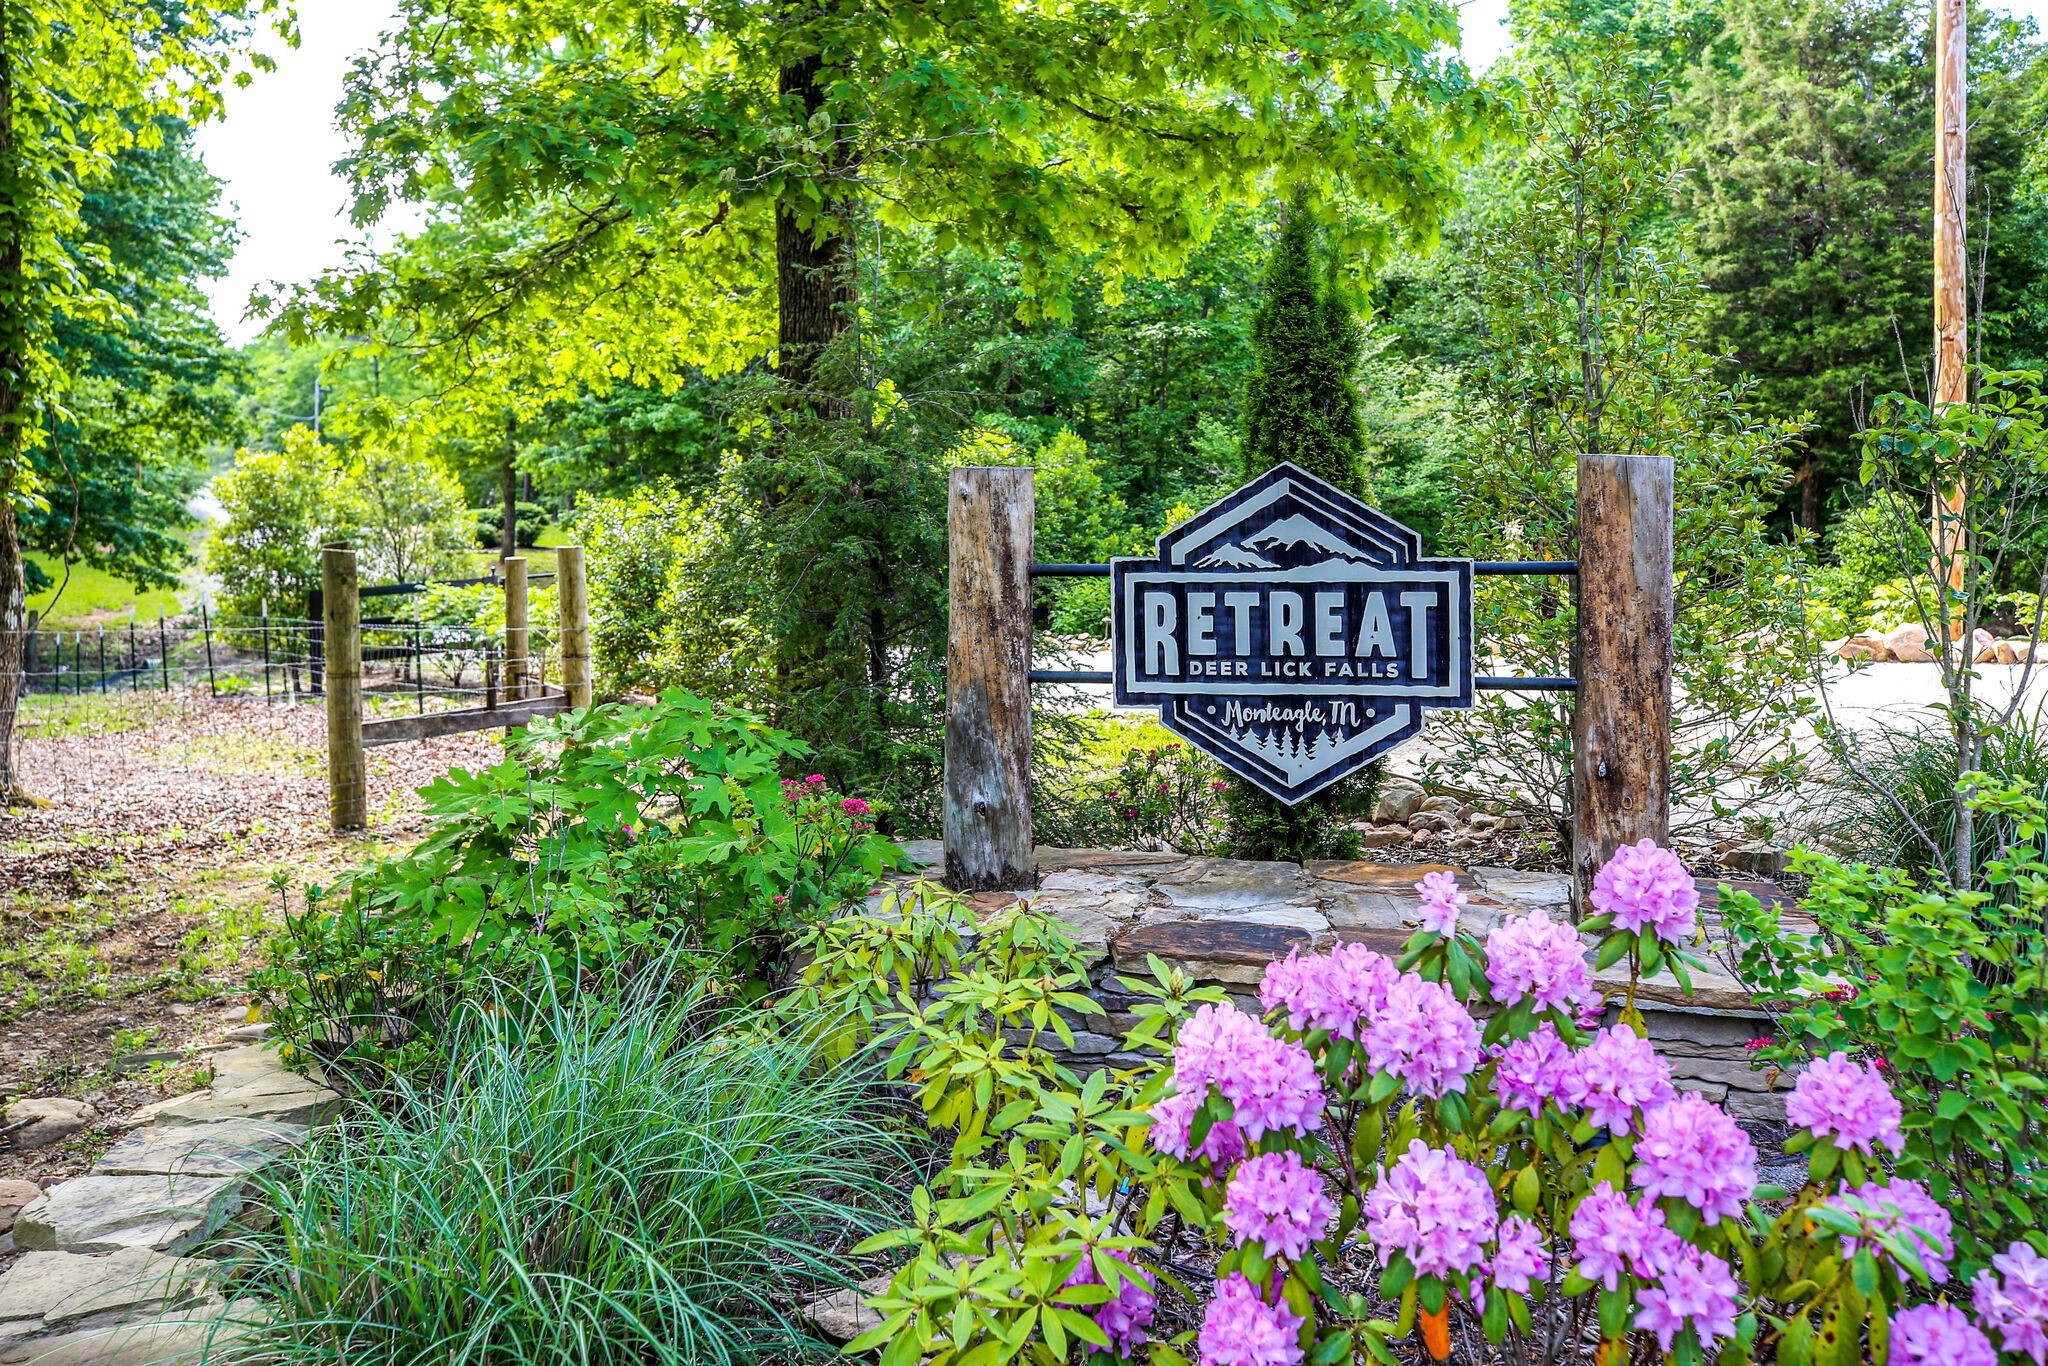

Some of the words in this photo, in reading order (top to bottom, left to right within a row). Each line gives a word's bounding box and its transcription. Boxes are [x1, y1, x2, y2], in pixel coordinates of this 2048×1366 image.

[1143, 591, 1438, 679] RETREAT
[1189, 661, 1248, 676] DEER
[1261, 662, 1312, 677] LICK
[1324, 662, 1399, 678] FALLS
[1221, 700, 1326, 732] Monteagle,
[1328, 701, 1361, 728] TN
